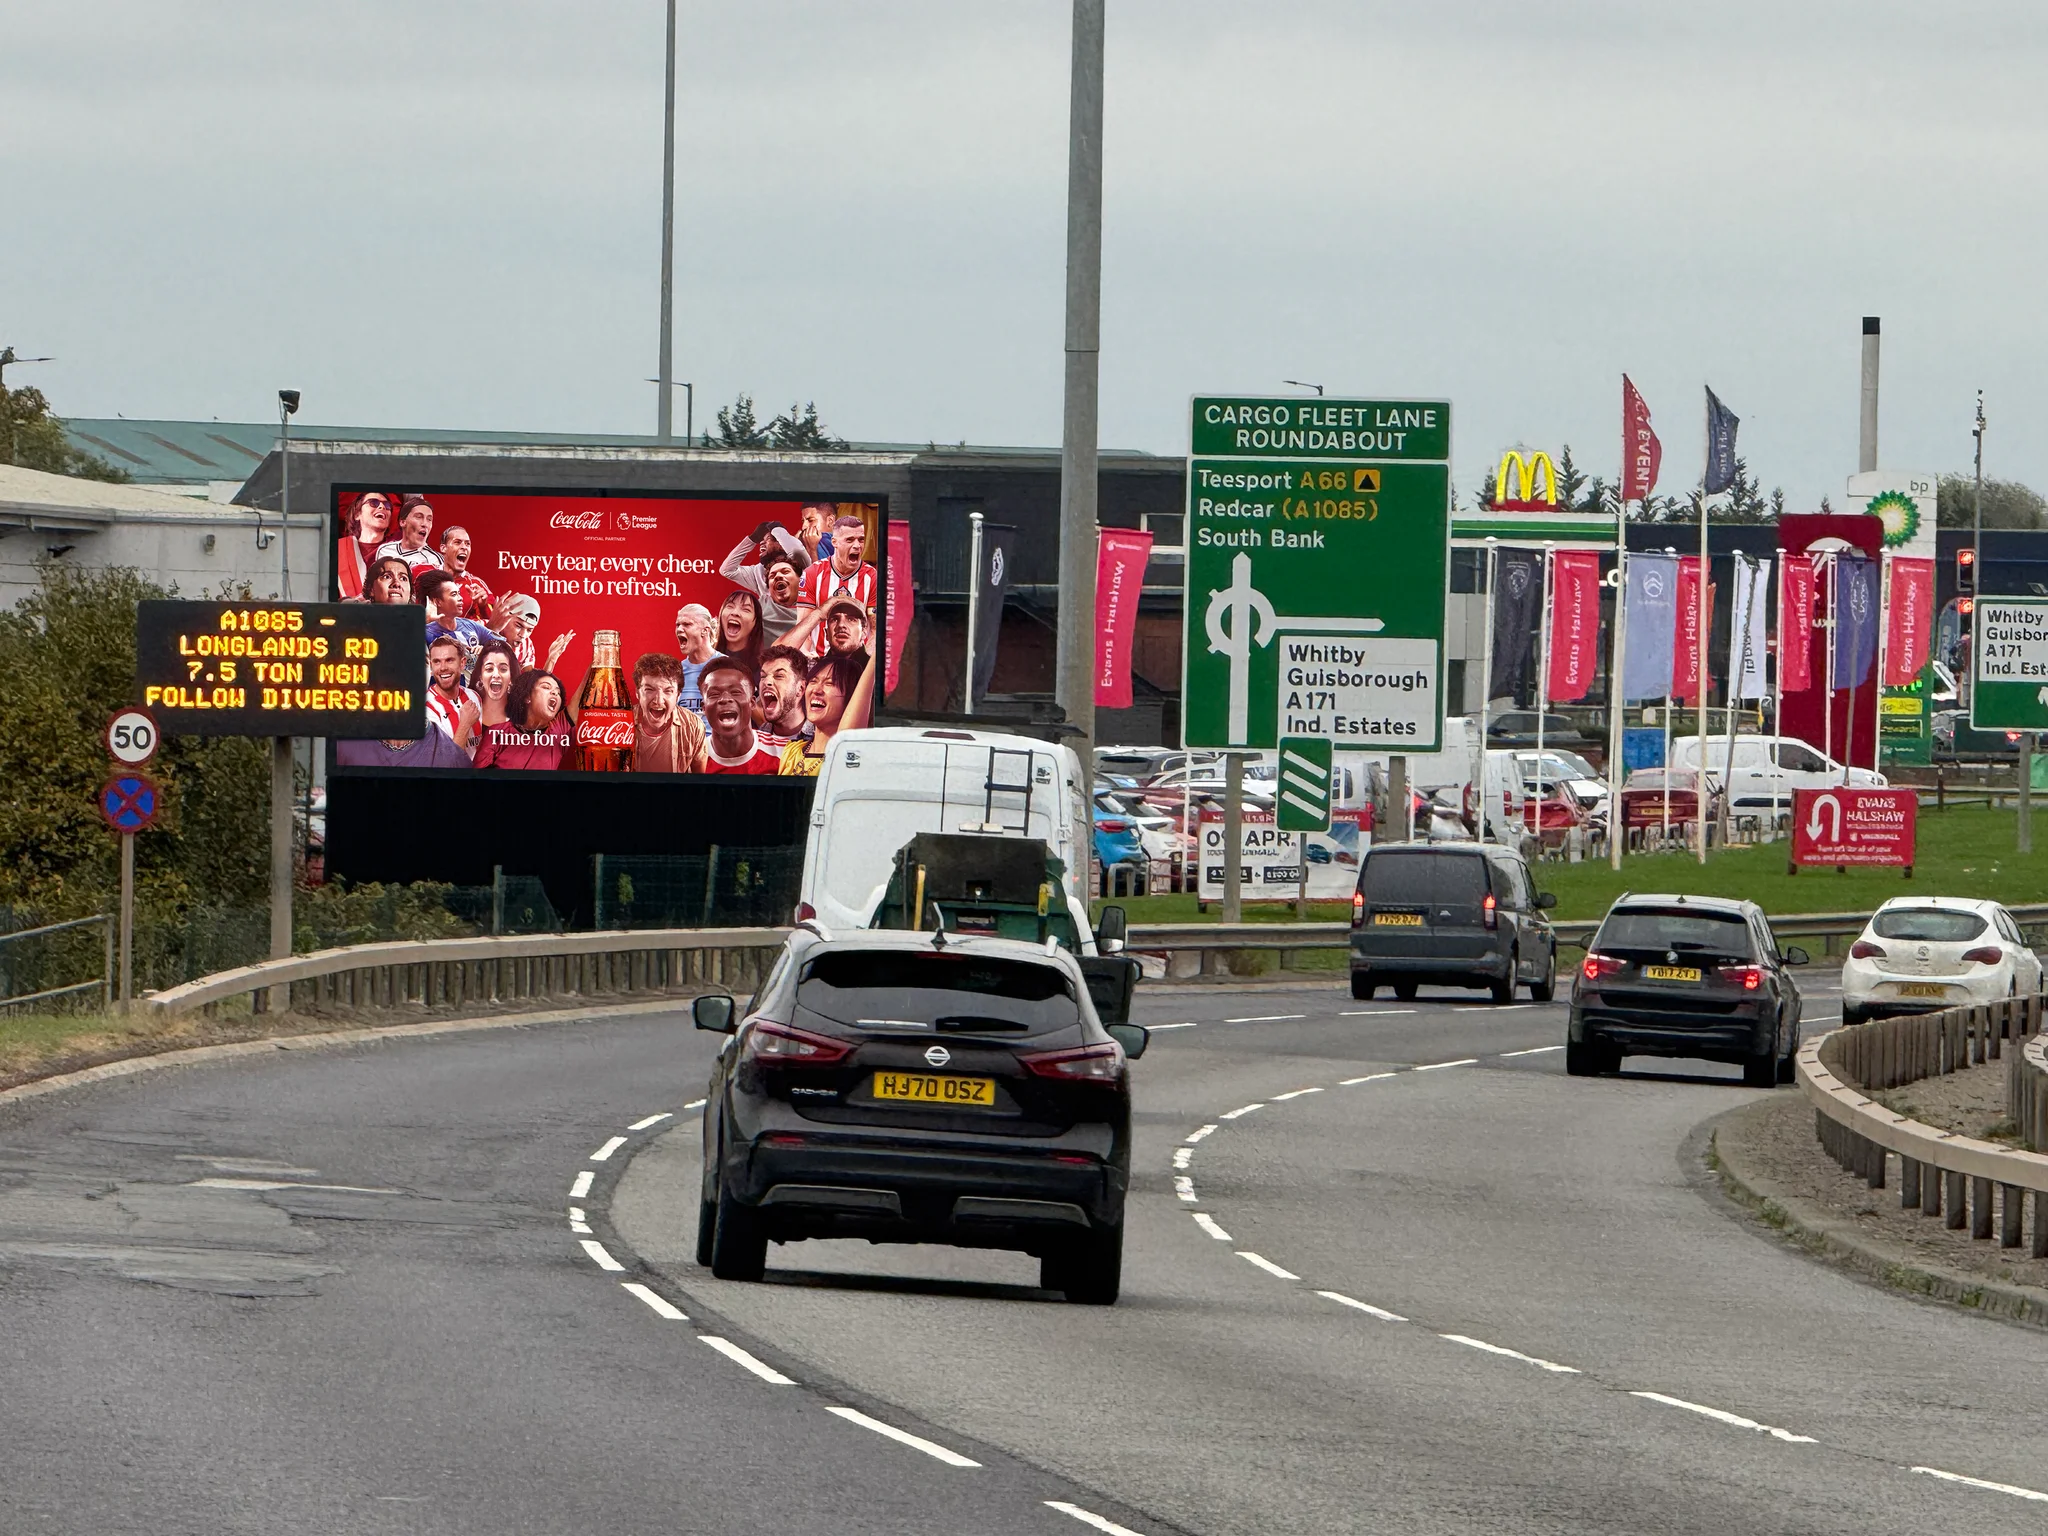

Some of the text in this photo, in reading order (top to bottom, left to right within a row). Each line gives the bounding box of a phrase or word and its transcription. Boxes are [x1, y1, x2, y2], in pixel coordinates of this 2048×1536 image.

[1204, 405, 1437, 428] CARGO FLEET LANE
[1236, 429, 1407, 450] ROUNDABOUT
[1636, 429, 1652, 498] EVENT
[1199, 469, 1292, 491] Teesport
[1910, 480, 1929, 496] bp
[550, 510, 604, 529] Coca-Cola
[632, 515, 657, 524] Premier
[1199, 497, 1378, 521] Redcar (A1085)
[632, 522, 657, 530] League
[1198, 528, 1325, 548] South Bank
[498, 551, 715, 576] Every tear, every cheer.
[531, 575, 681, 597] Time to refresh.
[1104, 561, 1126, 633] Halshaw
[220, 609, 303, 631] A1085
[1987, 610, 2044, 626] Whitby
[1986, 627, 2048, 641] Guisbor
[180, 635, 379, 659] LONGLANDS RD
[1288, 644, 1365, 667] Whitby
[1985, 644, 2022, 658] A171
[187, 661, 369, 684] 7.5 TON MGW
[1101, 640, 1114, 687] Evans
[1566, 643, 1580, 685] Evans
[1686, 645, 1699, 683] Evans
[1986, 662, 2048, 676] Ind. Est
[1287, 668, 1428, 691] Guisborough
[145, 686, 411, 711] FOLLOW DIVERSION
[1286, 692, 1336, 710] A171
[577, 720, 635, 745] Coca-Cola
[1287, 715, 1416, 735] Ind. Estates
[114, 725, 152, 749] 50
[489, 730, 531, 746] Time
[534, 730, 558, 747] for
[560, 735, 570, 747] a
[1857, 797, 1896, 809] EVANS
[1846, 810, 1906, 822] HALSHAW
[883, 1076, 986, 1101] HJ70 OSZ
